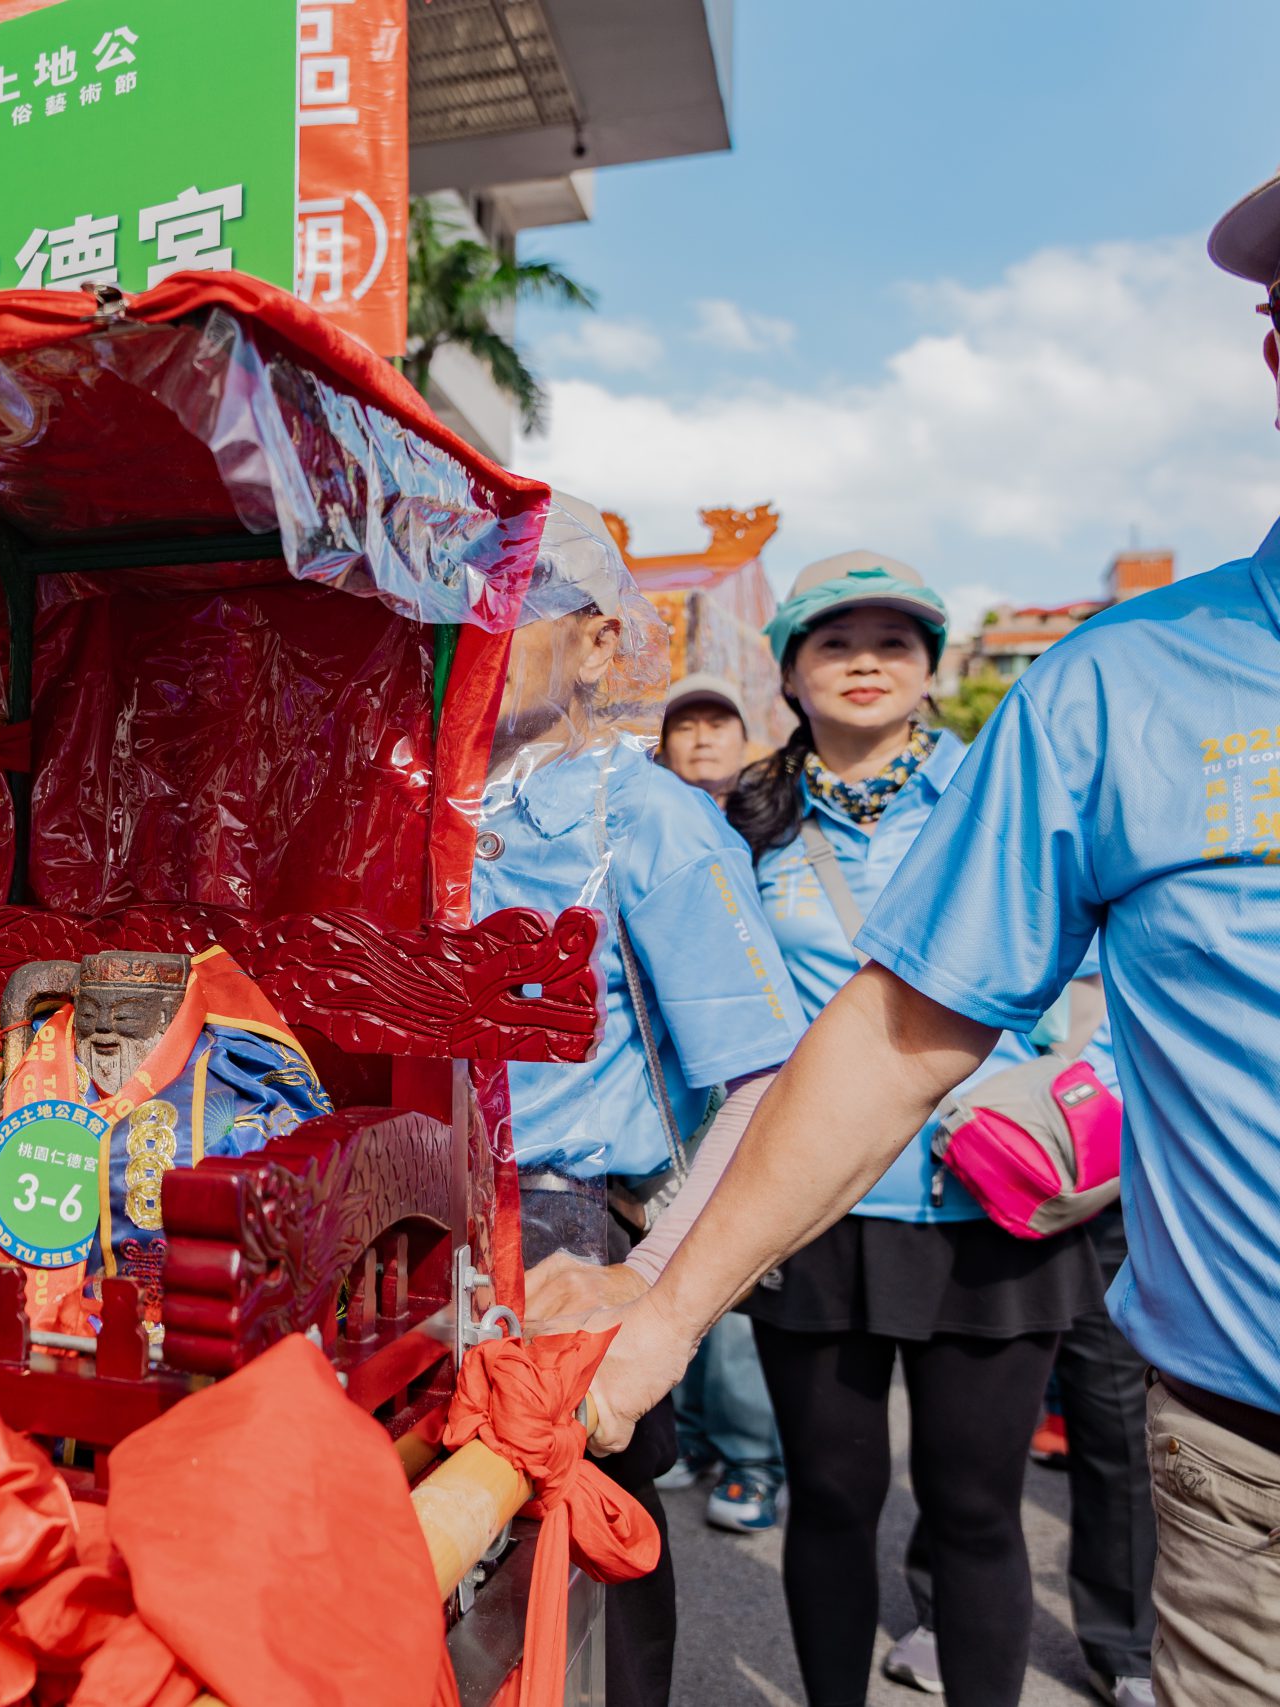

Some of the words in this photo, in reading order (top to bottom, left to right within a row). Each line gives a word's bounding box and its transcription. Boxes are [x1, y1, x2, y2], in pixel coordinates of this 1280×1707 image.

[710, 863, 737, 916] GOOD
[734, 918, 752, 942] TU
[745, 946, 767, 979] SEE
[763, 982, 785, 1020] YOU
[17, 1141, 99, 1173] 桃園仁德宮
[13, 1173, 83, 1223] 3-6
[15, 1243, 37, 1262] TU
[41, 1250, 74, 1266] SEE
